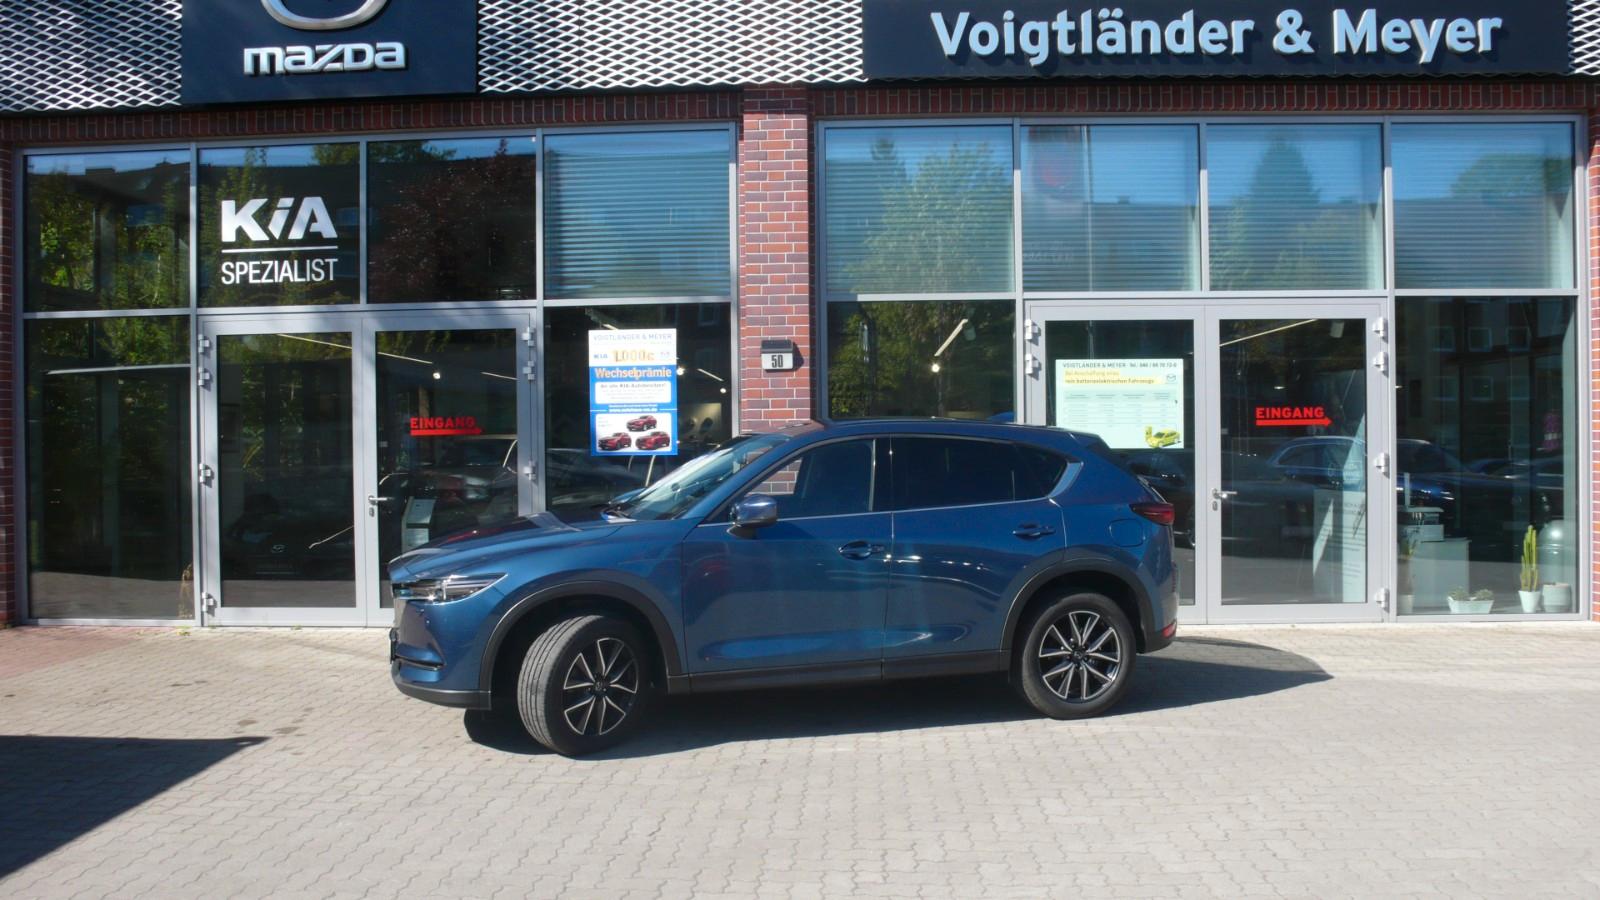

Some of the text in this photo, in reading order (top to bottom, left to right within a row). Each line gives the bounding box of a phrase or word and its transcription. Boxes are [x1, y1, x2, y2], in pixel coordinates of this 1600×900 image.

[930, 8, 1503, 66] Voigtländer & Meyer
[221, 258, 338, 285] SPEZIALIST
[771, 354, 784, 368] 50
[595, 367, 672, 380] Wechselprämie
[1255, 406, 1325, 419] EINGANG
[410, 416, 476, 429] EINGANG
